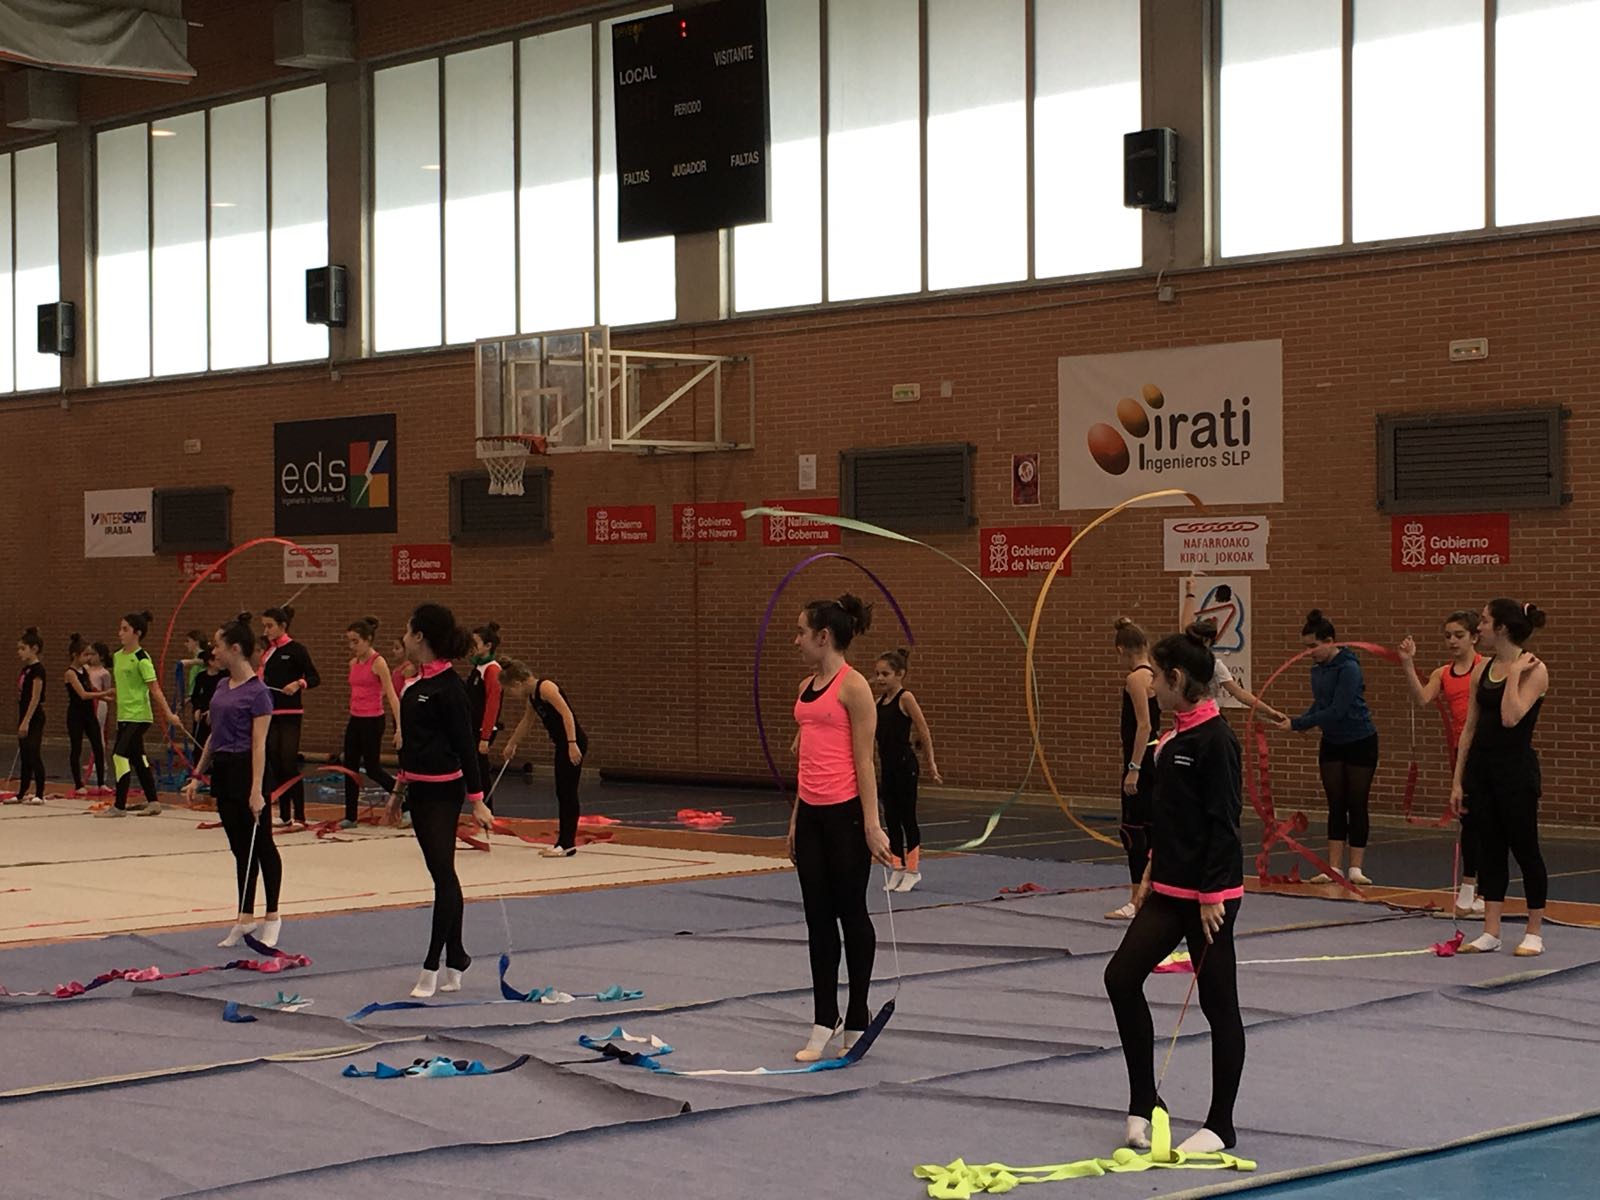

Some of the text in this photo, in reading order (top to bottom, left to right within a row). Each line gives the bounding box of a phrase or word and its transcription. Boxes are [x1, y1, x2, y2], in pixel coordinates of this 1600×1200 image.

[714, 45, 754, 67] VISITANTE
[619, 65, 657, 85] LOCAL
[674, 100, 702, 116] PERIODO
[730, 151, 759, 167] FALTAS
[672, 160, 707, 177] JUGADOR
[623, 169, 650, 185] FALTAS
[1154, 396, 1251, 451] irati
[1139, 443, 1250, 473] Ingenieros SLP
[281, 451, 346, 494] e.d.s
[100, 511, 147, 525] INTERSPORT
[698, 516, 732, 527] Gobierno
[105, 525, 133, 536] IRABIA
[610, 531, 620, 540] de
[698, 528, 738, 538] de Navarra
[787, 529, 829, 540] Gobernua
[1183, 537, 1250, 549] NAFARROAKO
[1430, 535, 1489, 549] Gobierno
[1011, 545, 1056, 557] Gobierno
[1180, 551, 1254, 565] KIROL JOKOAK
[1011, 559, 1024, 571] de
[1430, 552, 1500, 565] de Navarra
